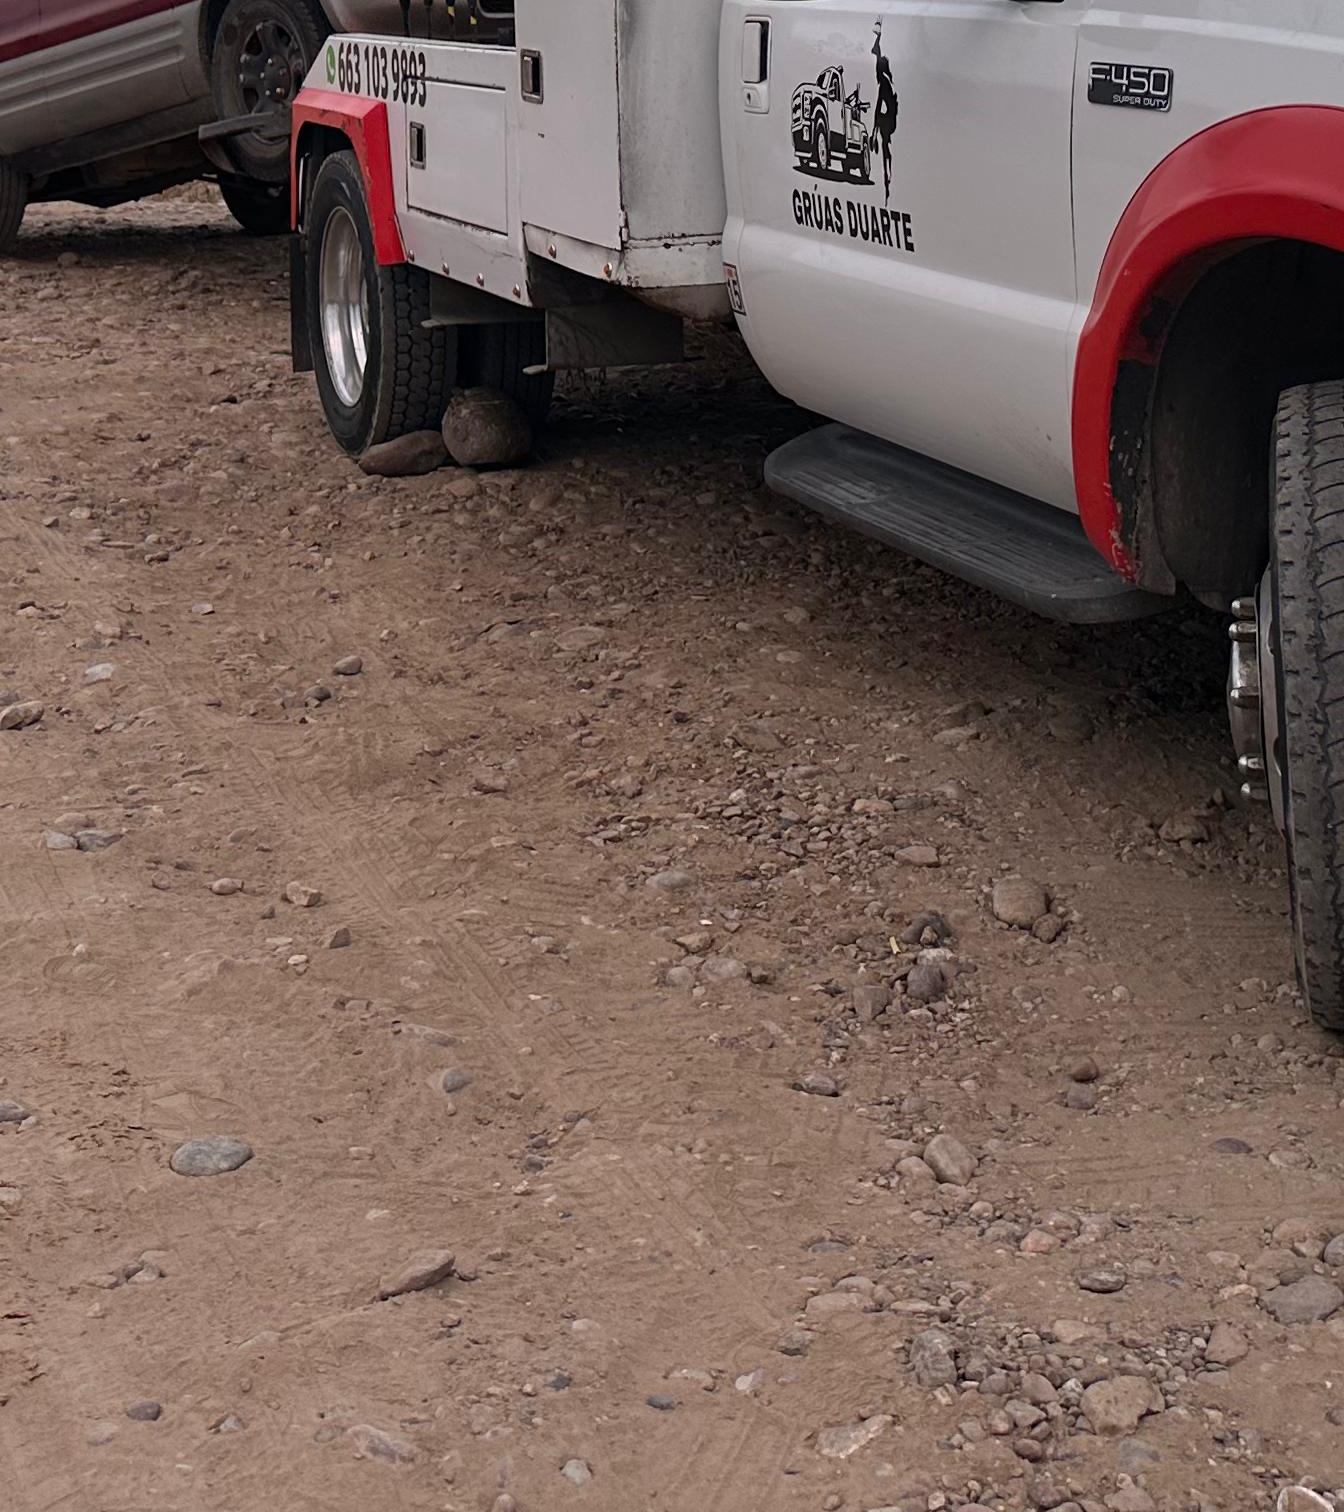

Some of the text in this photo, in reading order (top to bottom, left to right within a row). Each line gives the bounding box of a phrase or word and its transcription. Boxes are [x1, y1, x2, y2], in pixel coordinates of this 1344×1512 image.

[338, 42, 427, 107] 663 103 9893
[1113, 94, 1168, 107] SUPER DUTY
[792, 183, 915, 252] GRÚAS DUARTE
